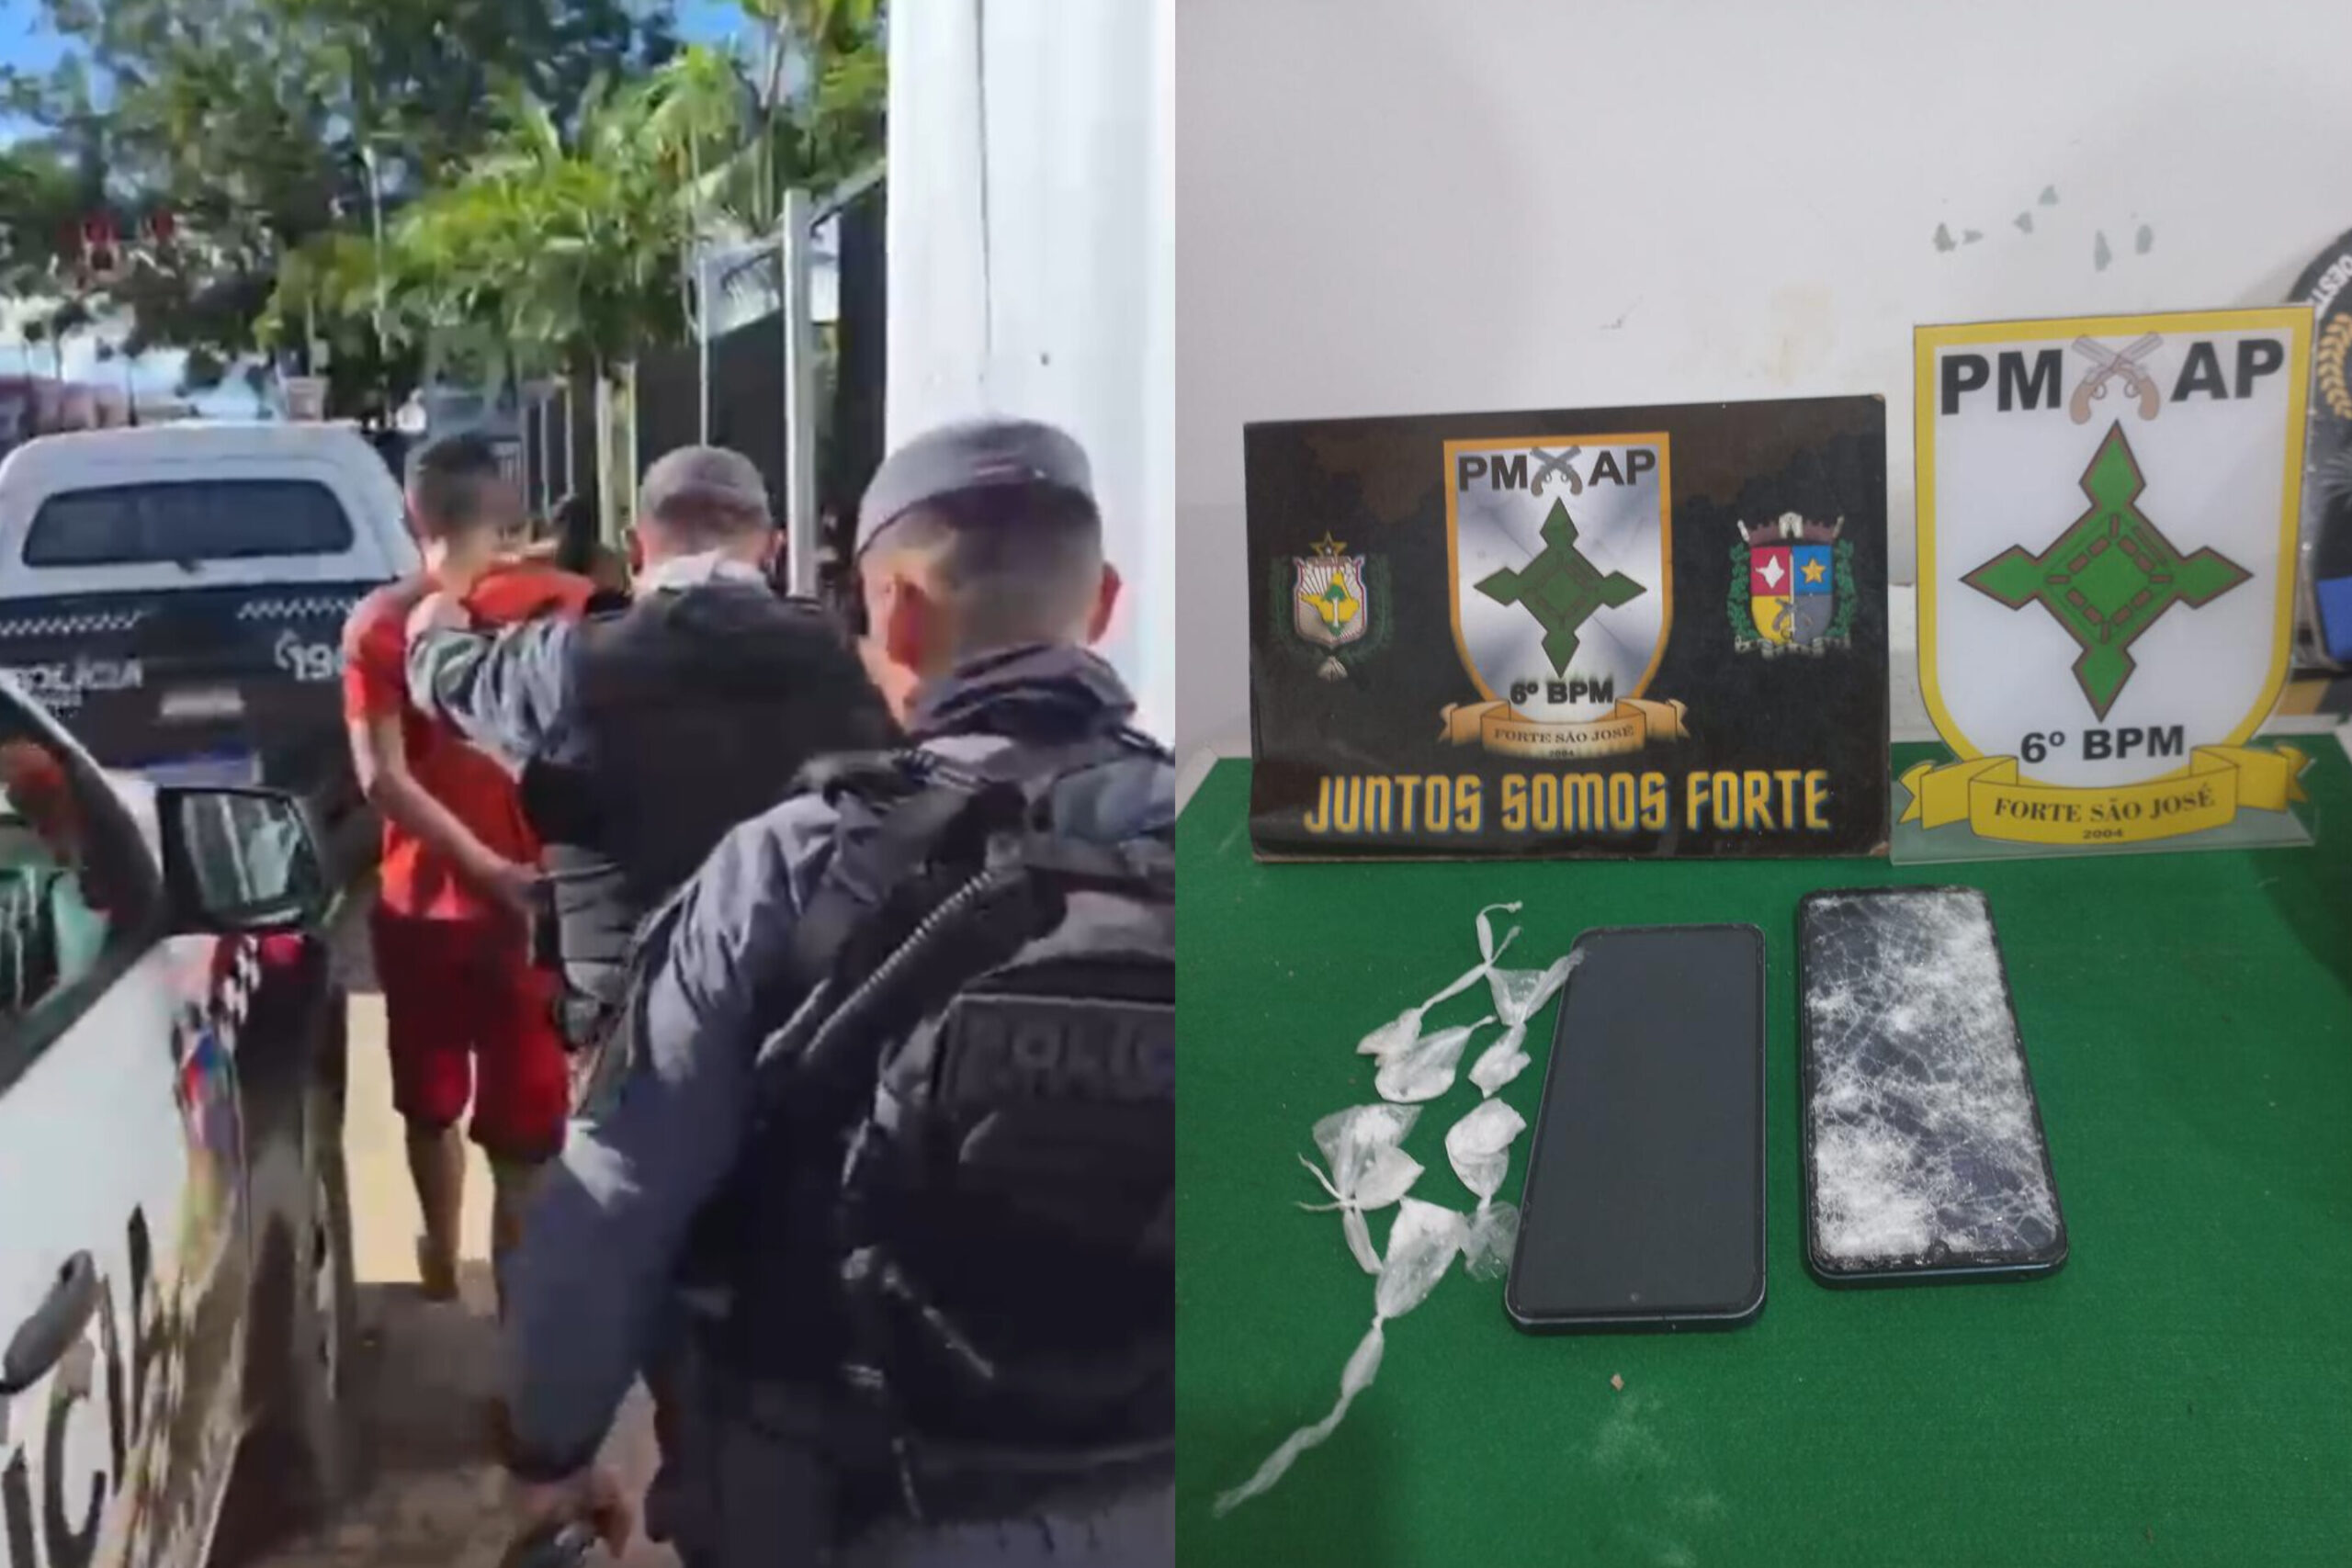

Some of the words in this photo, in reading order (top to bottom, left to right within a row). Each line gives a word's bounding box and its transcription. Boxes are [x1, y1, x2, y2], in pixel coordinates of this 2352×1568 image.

[1940, 348, 2064, 415] PM
[2170, 338, 2284, 403] AP
[1458, 455, 1528, 491] PM
[1588, 449, 1656, 487] AP
[1546, 678, 1613, 705] BPM
[1494, 728, 1552, 744] FORTE
[1555, 728, 1589, 744] SÃO
[2083, 725, 2184, 761] BPM
[1304, 774, 1482, 833] JUNTOS
[1501, 772, 1668, 832] SOMOS
[1686, 770, 1832, 830] FORTE
[1995, 796, 2082, 823] FORTE
[2090, 796, 2141, 822] SÃO
[2150, 783, 2216, 819] JOSÉ
[2082, 829, 2125, 840] 2004
